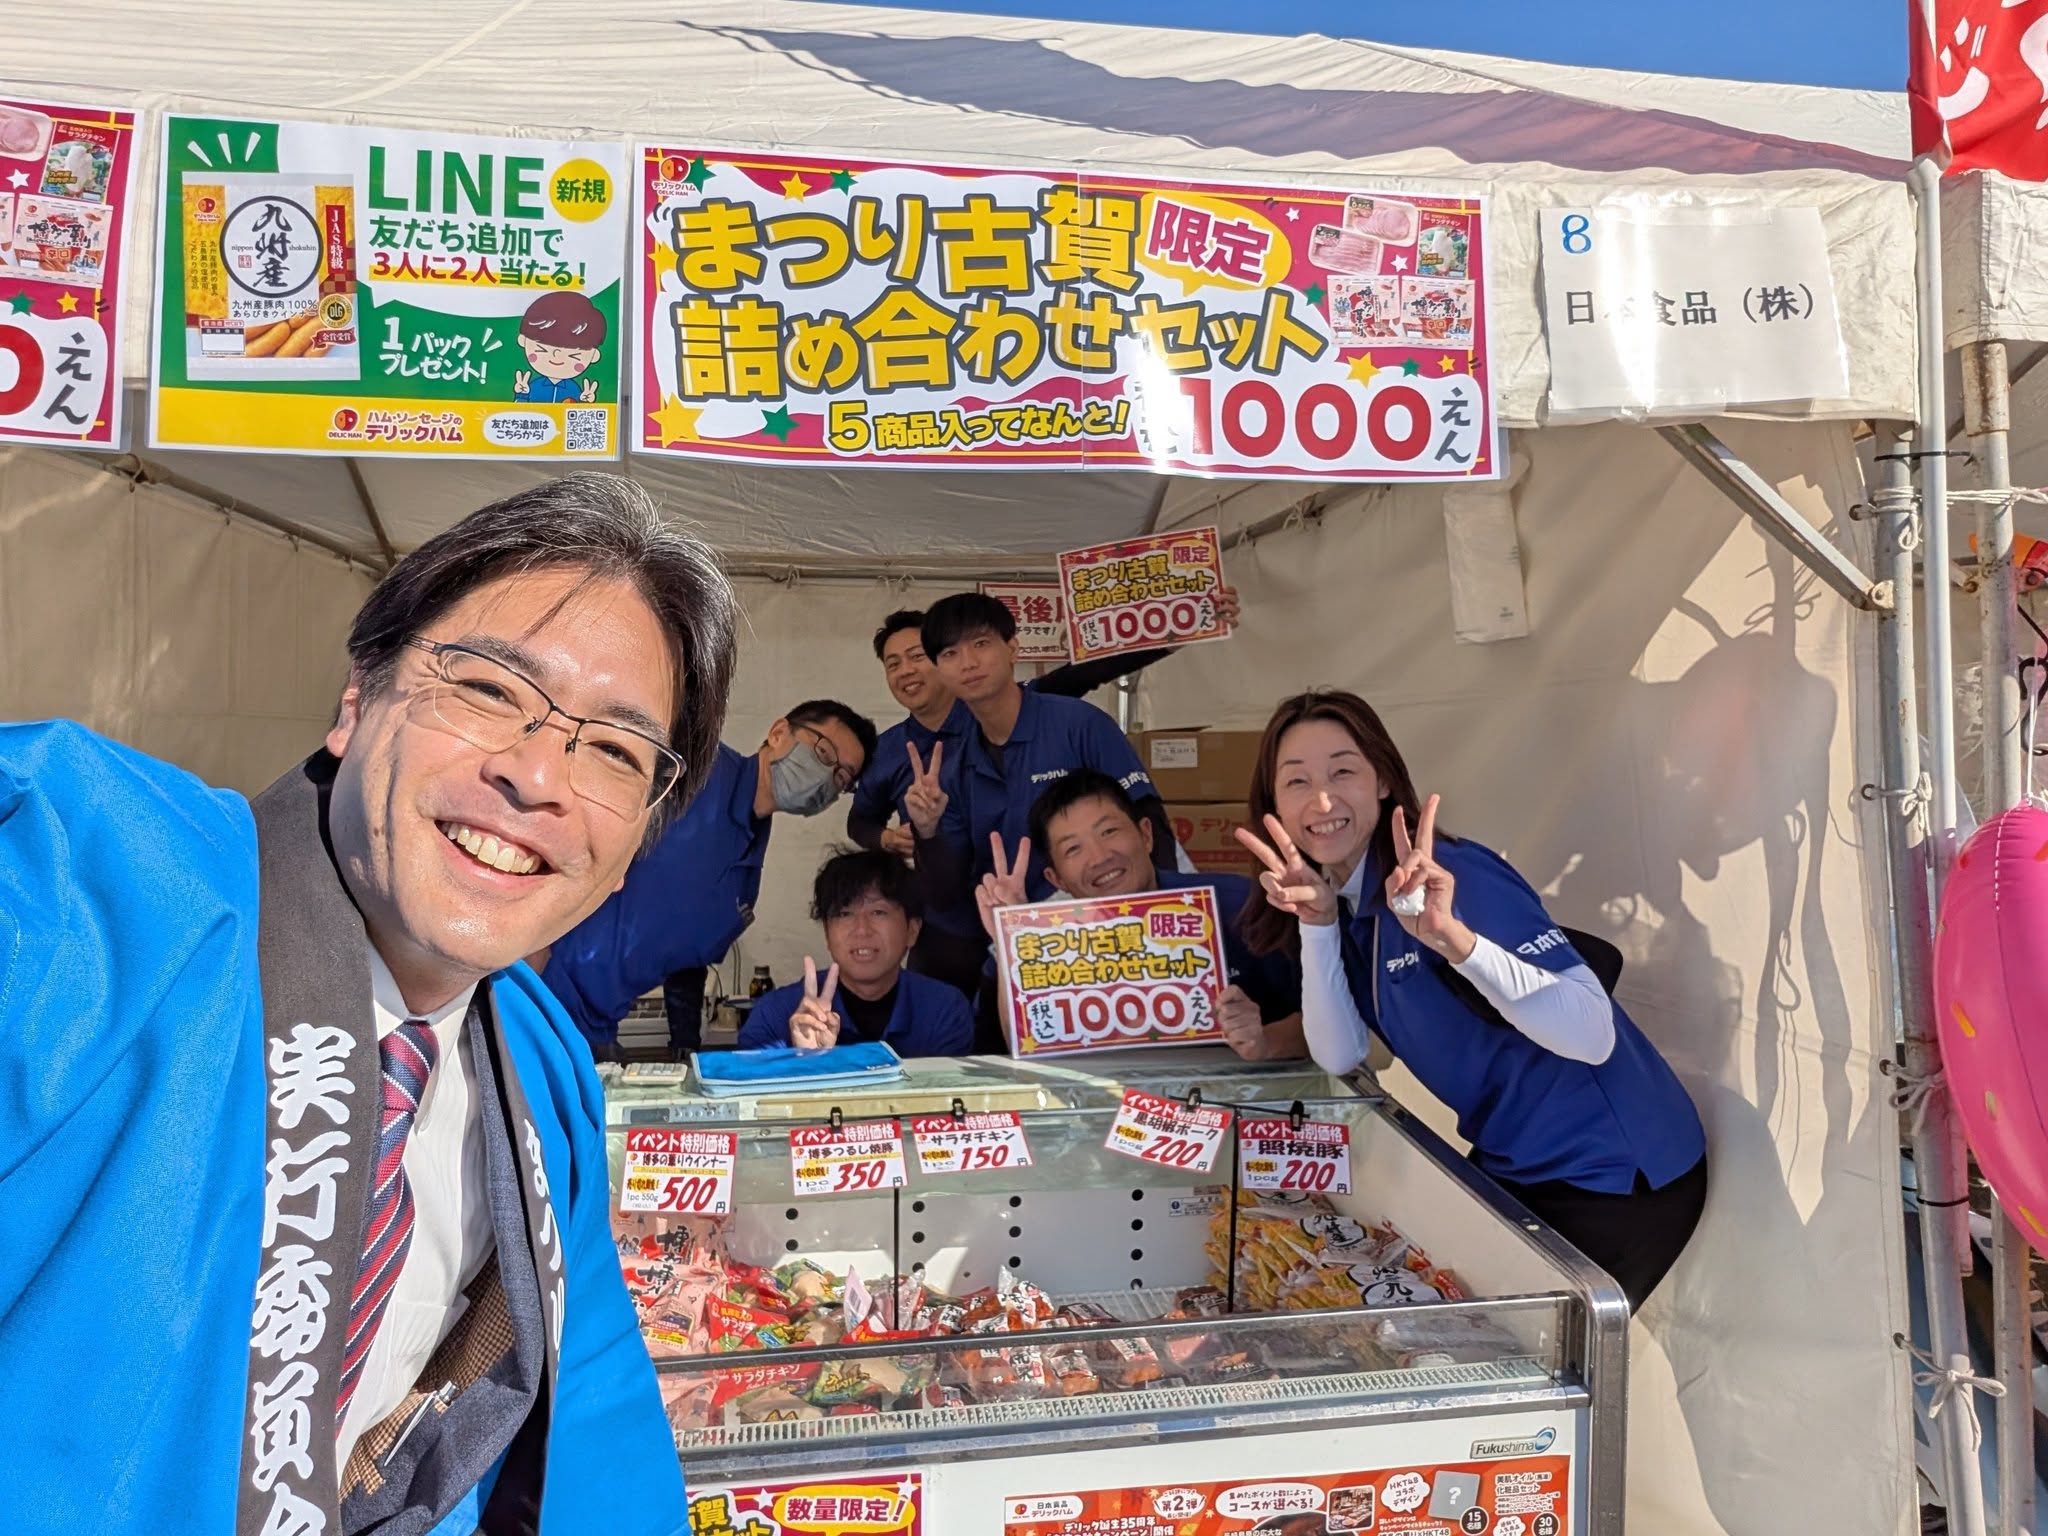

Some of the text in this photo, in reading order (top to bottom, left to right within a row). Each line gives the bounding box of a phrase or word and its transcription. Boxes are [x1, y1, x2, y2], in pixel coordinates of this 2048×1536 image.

[368, 145, 545, 220] LINE
[556, 178, 607, 204] 新規
[653, 181, 696, 191] デリックハム
[252, 203, 292, 287] 九州産
[330, 209, 344, 270] JAS特級
[369, 215, 565, 257] 友だち追加で
[672, 186, 1142, 297] まつり古賀
[1146, 200, 1271, 283] 限定
[1562, 214, 1592, 255] 8
[231, 244, 317, 252] nippon shokuhin
[232, 299, 318, 311] 九州産豚肉 100%
[671, 285, 1328, 400] 詰め合わせセット
[43, 331, 93, 426] えん
[379, 353, 488, 384] プレゼント!
[367, 411, 463, 425] ハム・ソーセージの
[491, 418, 550, 430] 友だち追加は
[1178, 376, 1433, 463] 1000
[1434, 387, 1472, 464] えん
[365, 424, 464, 442] デリックハム
[496, 429, 544, 441] こちらから!
[1173, 546, 1211, 565] 限定
[1071, 554, 1169, 590] まつり古賀
[1074, 571, 1215, 614] 詰め合わせセット
[1097, 603, 1196, 643] 1000
[1199, 600, 1213, 629] えん
[1149, 912, 1205, 938] 限定
[1015, 922, 1147, 961] まつり古賀
[1020, 948, 1210, 990] 詰め合わせセット
[1054, 990, 1186, 1035] 1000
[1190, 990, 1211, 1028] えん
[795, 1123, 896, 1146] イベント特別価格
[916, 1113, 1015, 1133] イベント特別価格
[631, 1132, 731, 1154] イベント特別価格
[808, 1141, 894, 1160] 博多つるし焼豚
[931, 1130, 1016, 1146] サラダチキン
[1258, 1140, 1344, 1160] 照焼豚
[642, 1153, 728, 1168] 博多の薫りウインナー
[960, 1144, 1009, 1170] 150
[1017, 1156, 1028, 1167] 円
[1141, 1135, 1208, 1171] 200 円
[833, 1160, 904, 1192] 350 円
[1280, 1159, 1337, 1191] 200
[1336, 1183, 1348, 1194] 円
[657, 1176, 727, 1213] 500 円
[733, 1365, 800, 1385] サラダチキン
[1475, 1441, 1534, 1456] Fukushima
[1389, 1476, 1420, 1490] HKT48
[1395, 1487, 1416, 1498] コラボ
[786, 1496, 909, 1522] 数量限定!
[1031, 1508, 1074, 1518] デリックハム
[1393, 1495, 1420, 1507] デザイン
[1467, 1511, 1482, 1522] 15
[1538, 1516, 1553, 1528] 30
